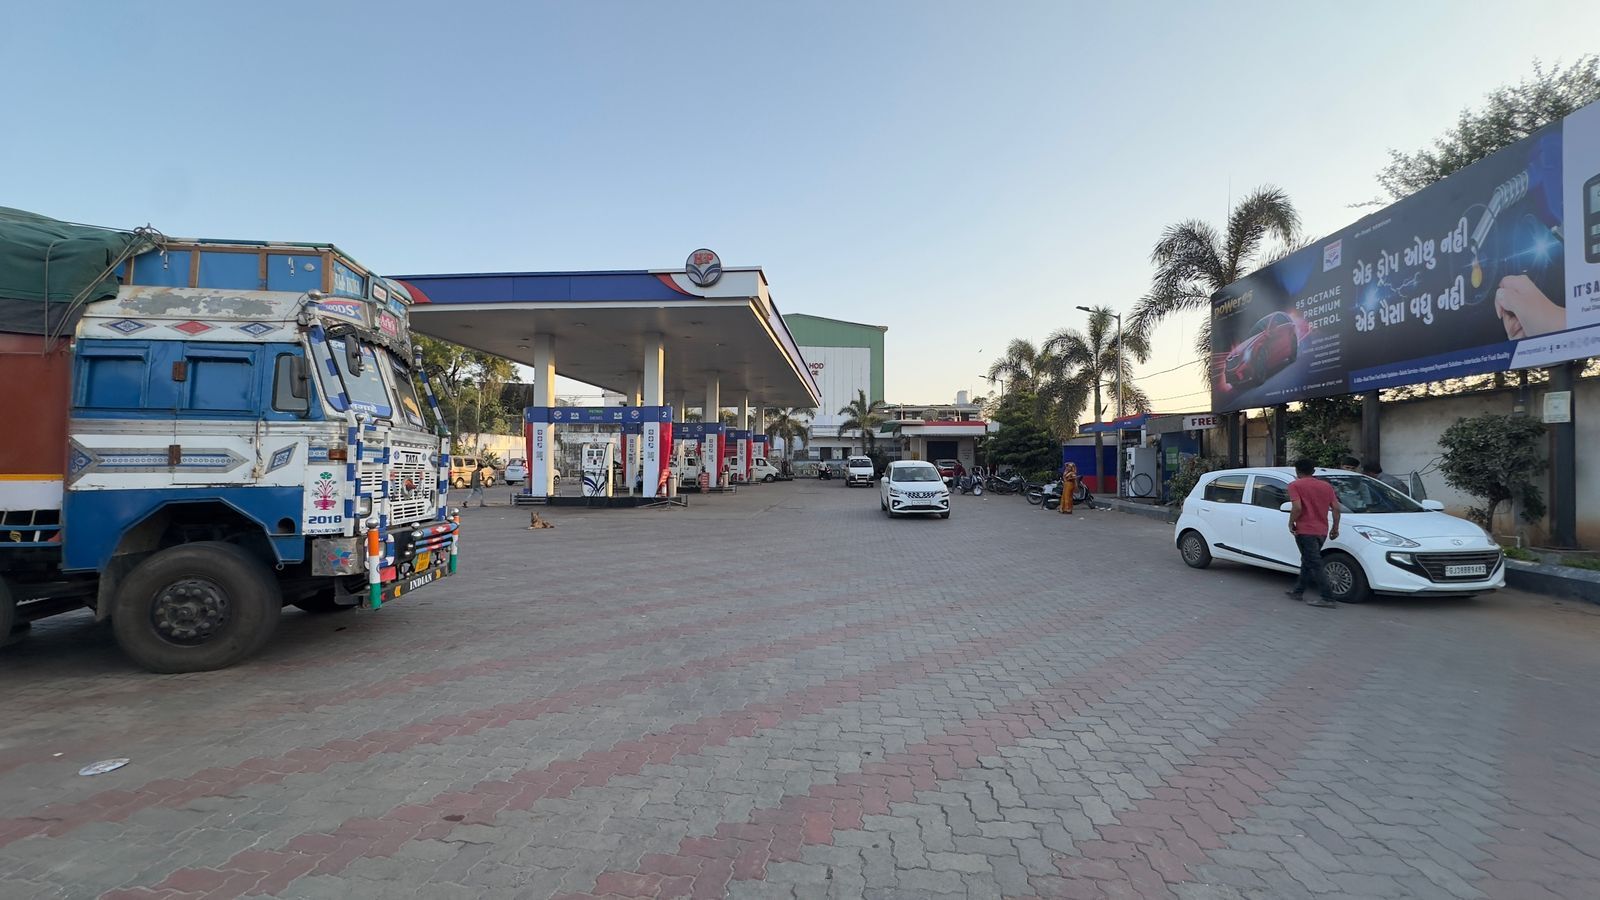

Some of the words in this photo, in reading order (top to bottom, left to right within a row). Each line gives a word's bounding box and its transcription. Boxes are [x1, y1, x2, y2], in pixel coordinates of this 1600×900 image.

[1295, 299, 1305, 310] 95
[1307, 286, 1341, 305] OCTANE
[1303, 299, 1341, 319] PREMIUM
[1308, 314, 1341, 330] PETROL
[1191, 416, 1217, 426] FREE
[405, 454, 419, 463] TATA
[308, 515, 342, 524] 2018
[409, 572, 433, 591] INDIAN
